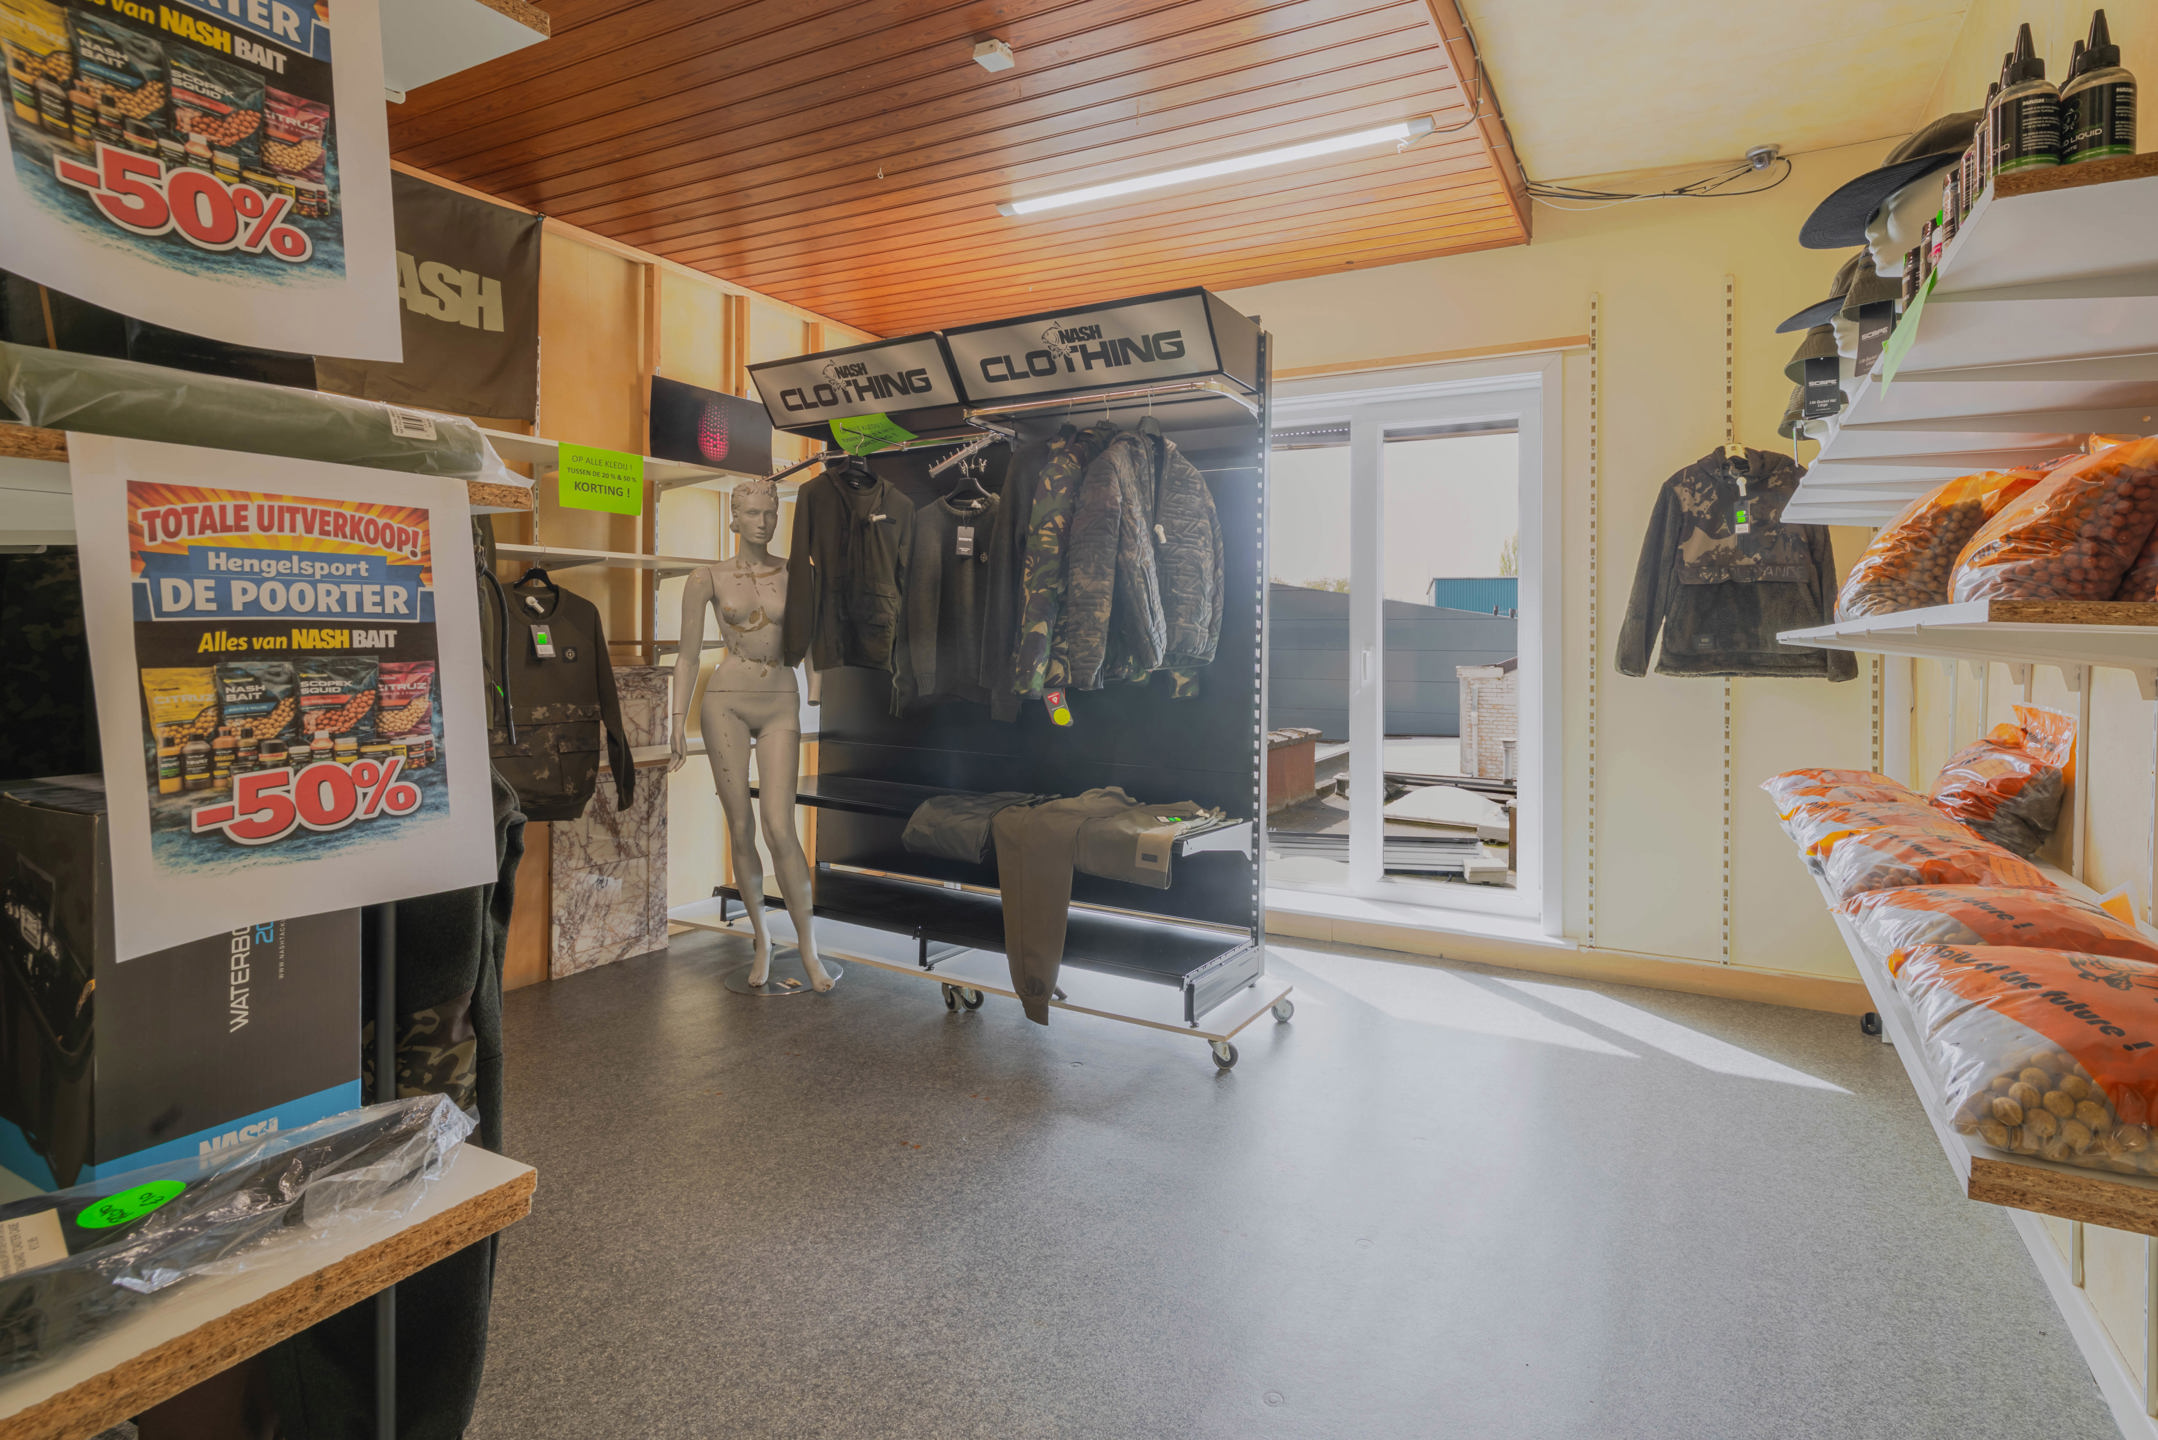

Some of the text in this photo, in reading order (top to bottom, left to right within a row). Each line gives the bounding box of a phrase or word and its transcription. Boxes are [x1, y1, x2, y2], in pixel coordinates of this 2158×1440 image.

[79, 38, 129, 62] NASH
[111, 0, 287, 75] van NASH BAIT
[80, 47, 126, 69] BAIT
[171, 69, 234, 99] SCOPEX
[171, 77, 222, 101] SQUID
[56, 144, 309, 260] -50%
[1058, 324, 1102, 345] NASH
[980, 330, 1185, 383] CLOTHING
[834, 362, 868, 379] NASH
[780, 368, 932, 412] CLOTHING
[567, 466, 591, 476] TUSSEN
[592, 470, 600, 478] DE
[571, 454, 583, 463] OP
[585, 457, 602, 467] ALLE
[574, 480, 624, 497] KORTING
[141, 503, 420, 560] TOTALE UITVERKOOP!
[208, 551, 369, 580] Hengelsport
[159, 577, 410, 615] DE POORTER
[197, 628, 398, 654] Alles van NASH BAIT
[225, 684, 266, 694] NASH
[225, 692, 262, 702] BAIT
[194, 758, 419, 842] -50%
[2039, 990, 2126, 1037] future
